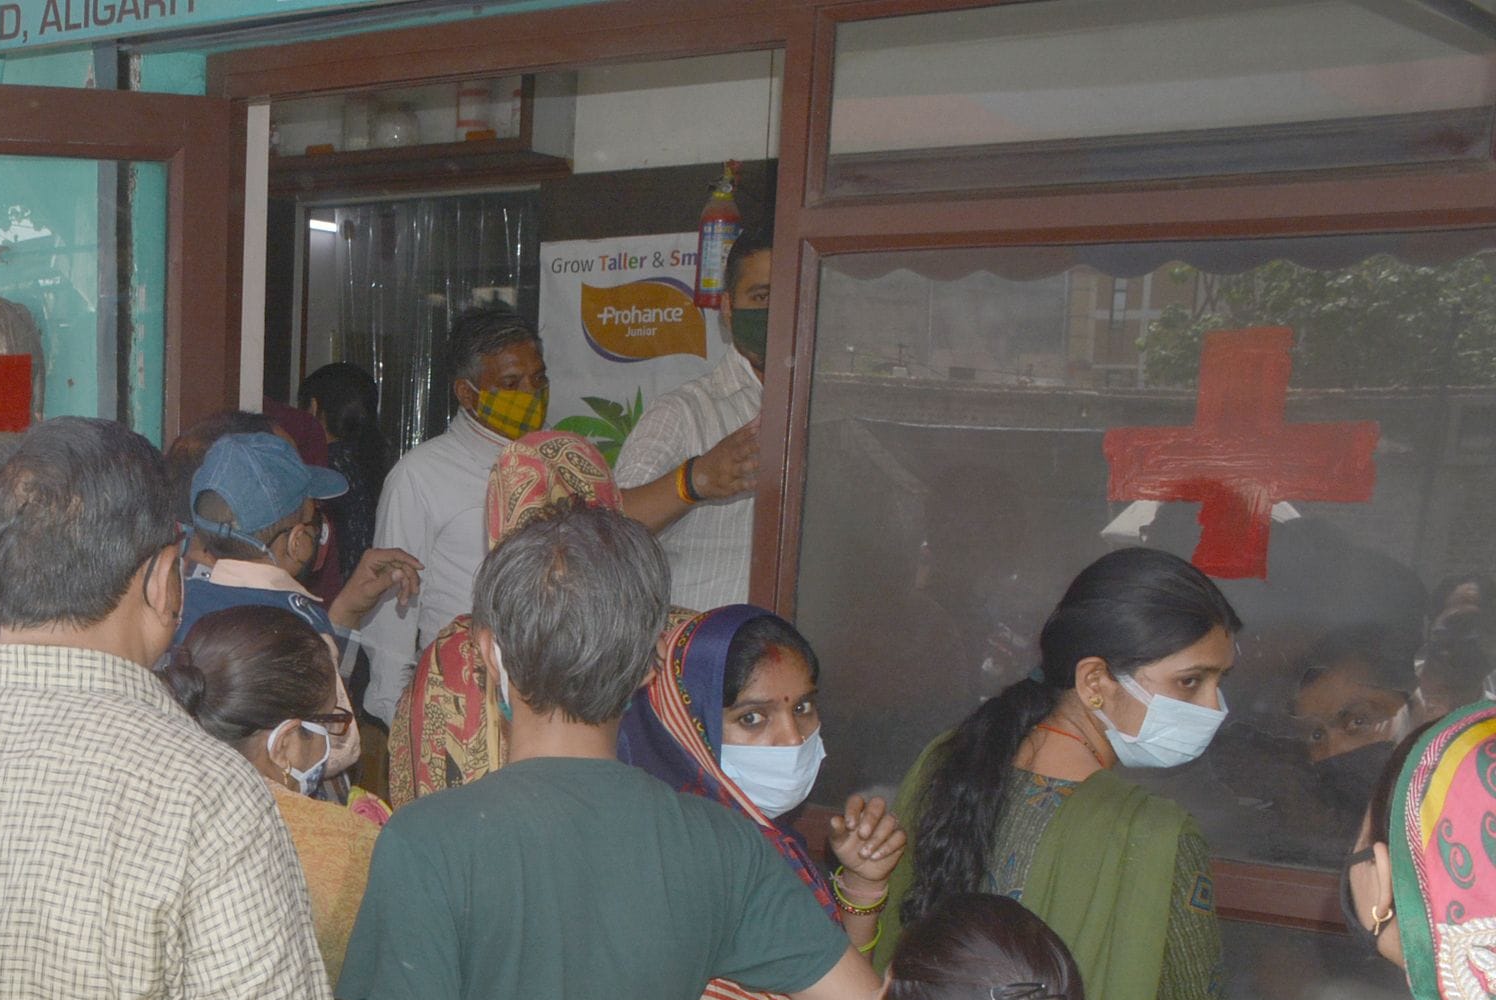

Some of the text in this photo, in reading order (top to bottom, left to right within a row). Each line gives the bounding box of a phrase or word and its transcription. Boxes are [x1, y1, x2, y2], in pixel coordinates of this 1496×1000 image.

[551, 249, 698, 274] Grow Taller & Sm
[597, 303, 685, 326] Prohance
[624, 326, 658, 338] Junior
